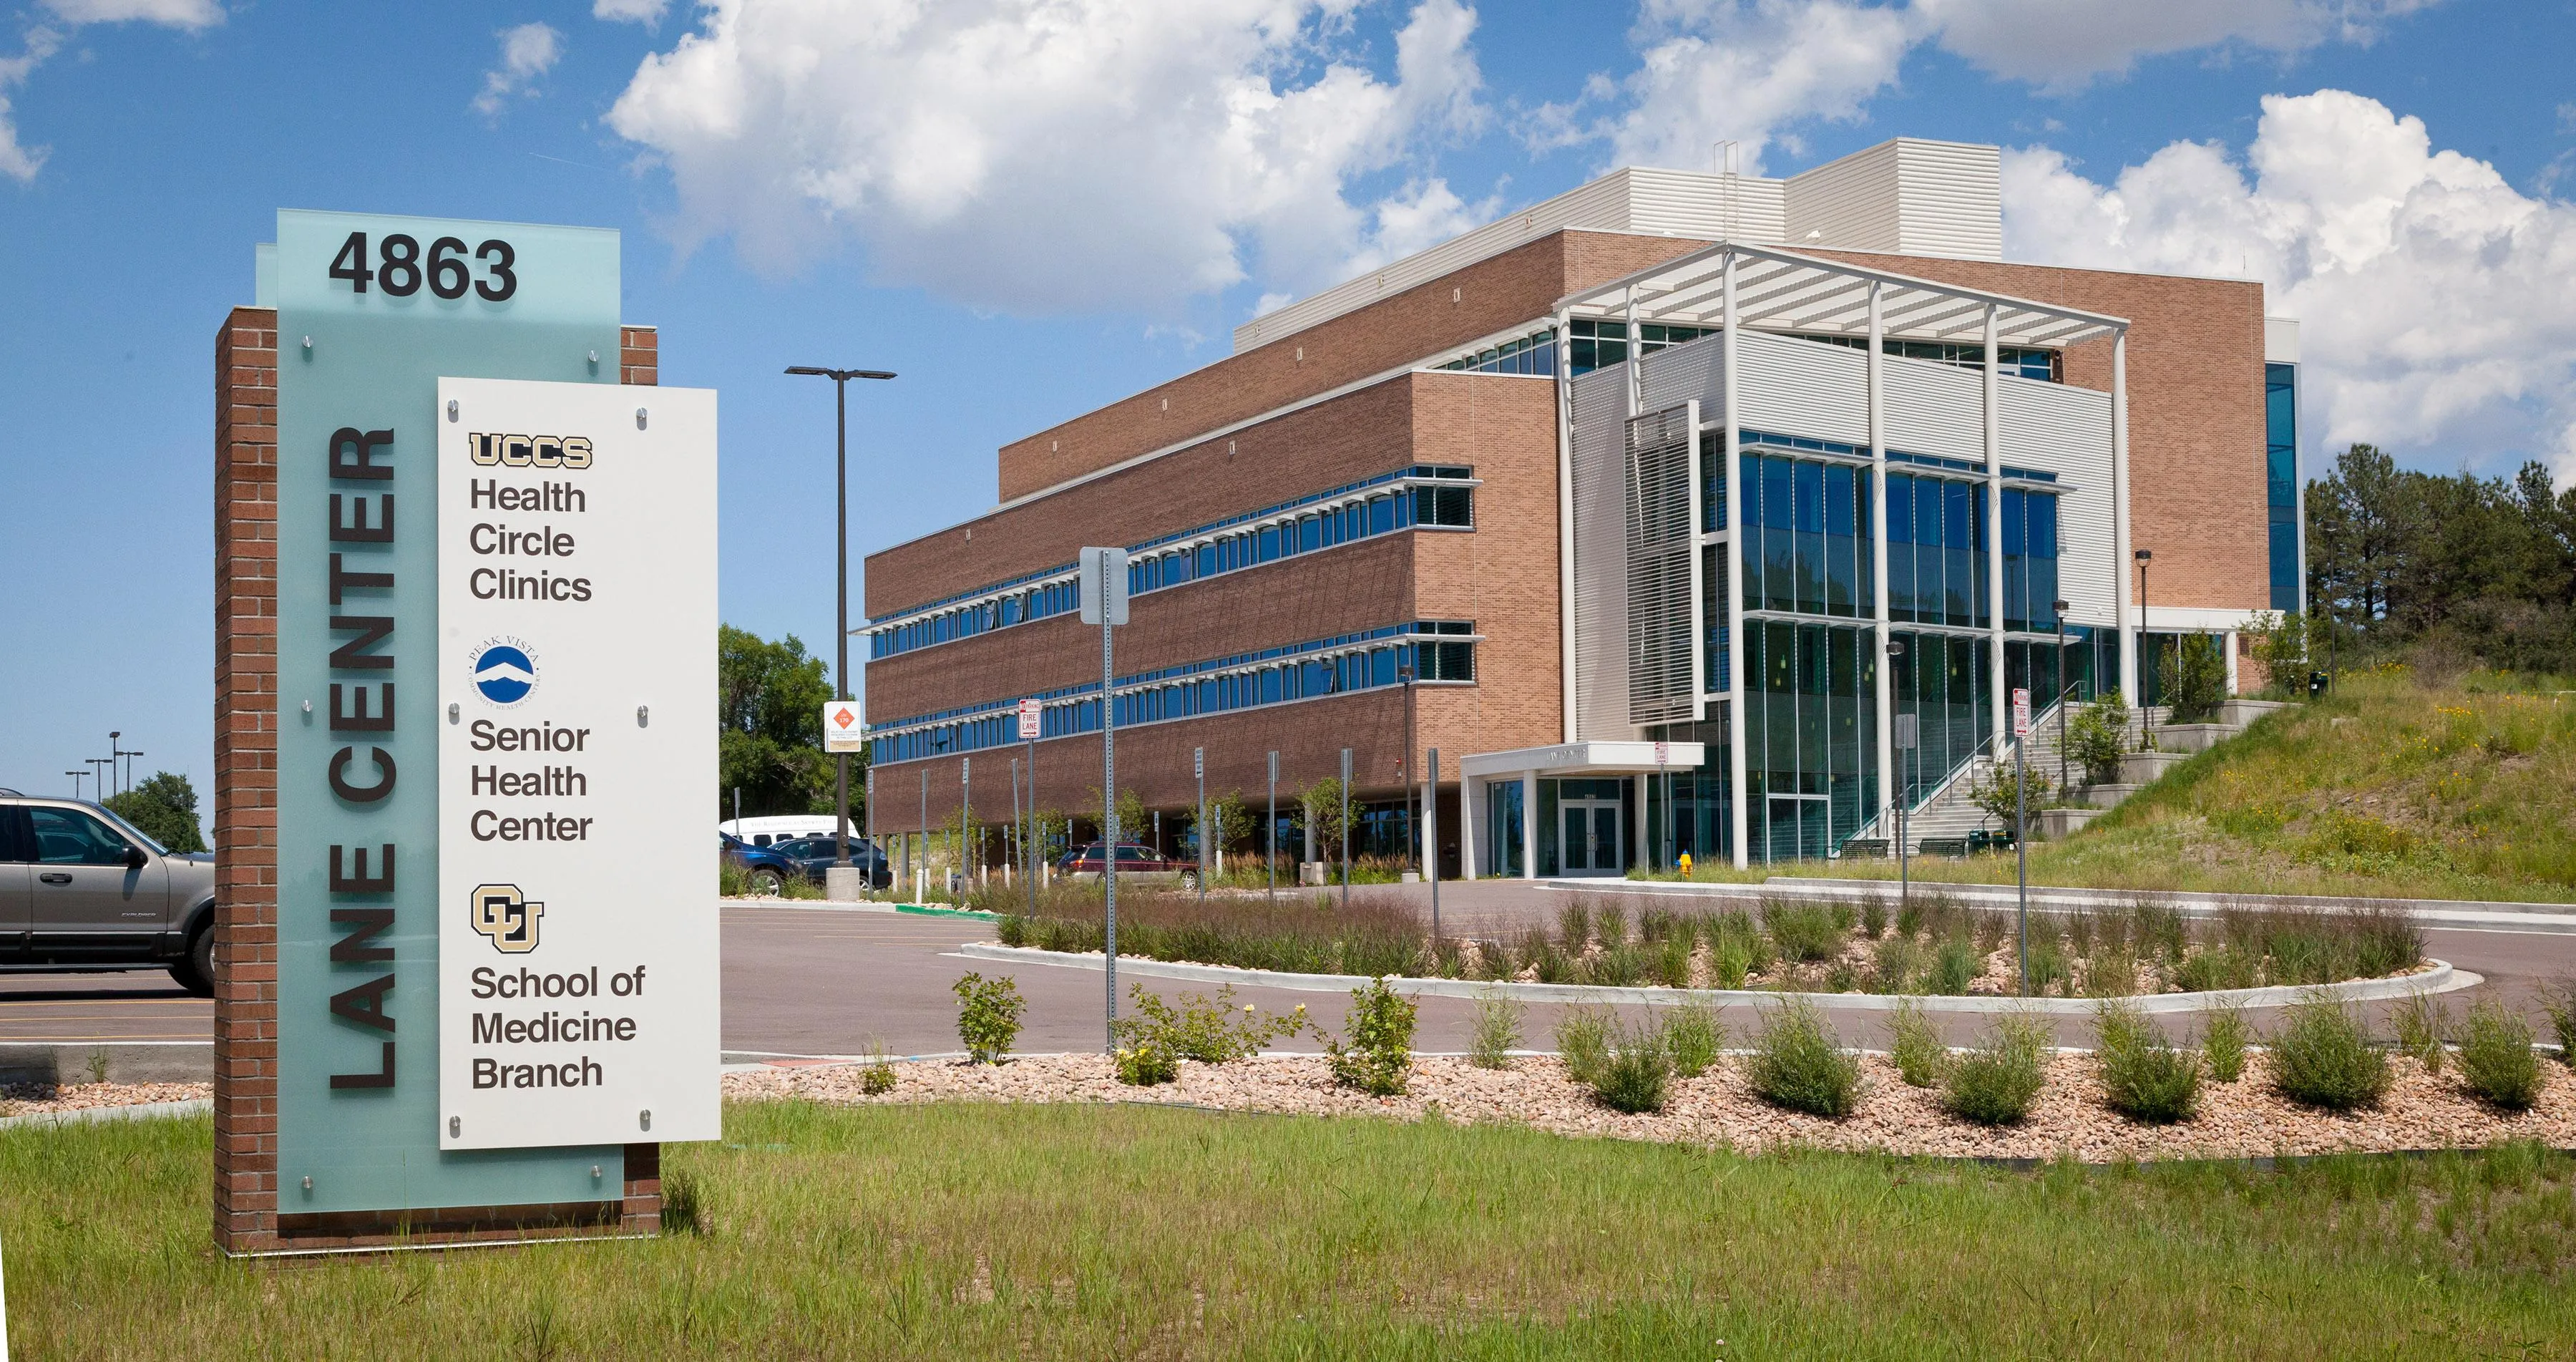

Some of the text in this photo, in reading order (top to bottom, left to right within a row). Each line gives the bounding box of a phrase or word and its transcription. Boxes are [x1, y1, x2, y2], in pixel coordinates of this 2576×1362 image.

[329, 232, 517, 302] 4863
[469, 432, 592, 470] UCCS
[471, 479, 585, 512] Health
[469, 523, 575, 557] Circle
[470, 568, 592, 602] Clinics
[469, 636, 539, 662] PEAK VISTA
[496, 701, 524, 711] HEALTH
[2016, 707, 2026, 716] FIRE
[2016, 718, 2026, 727] LANE
[470, 719, 590, 752] Senior
[328, 427, 396, 1089] LANE CENTER
[472, 765, 586, 797] Health
[471, 809, 593, 842] Center
[471, 884, 545, 954] CU
[471, 965, 645, 999] School of
[472, 1011, 637, 1044] Medicine
[472, 1056, 602, 1089] Branch
